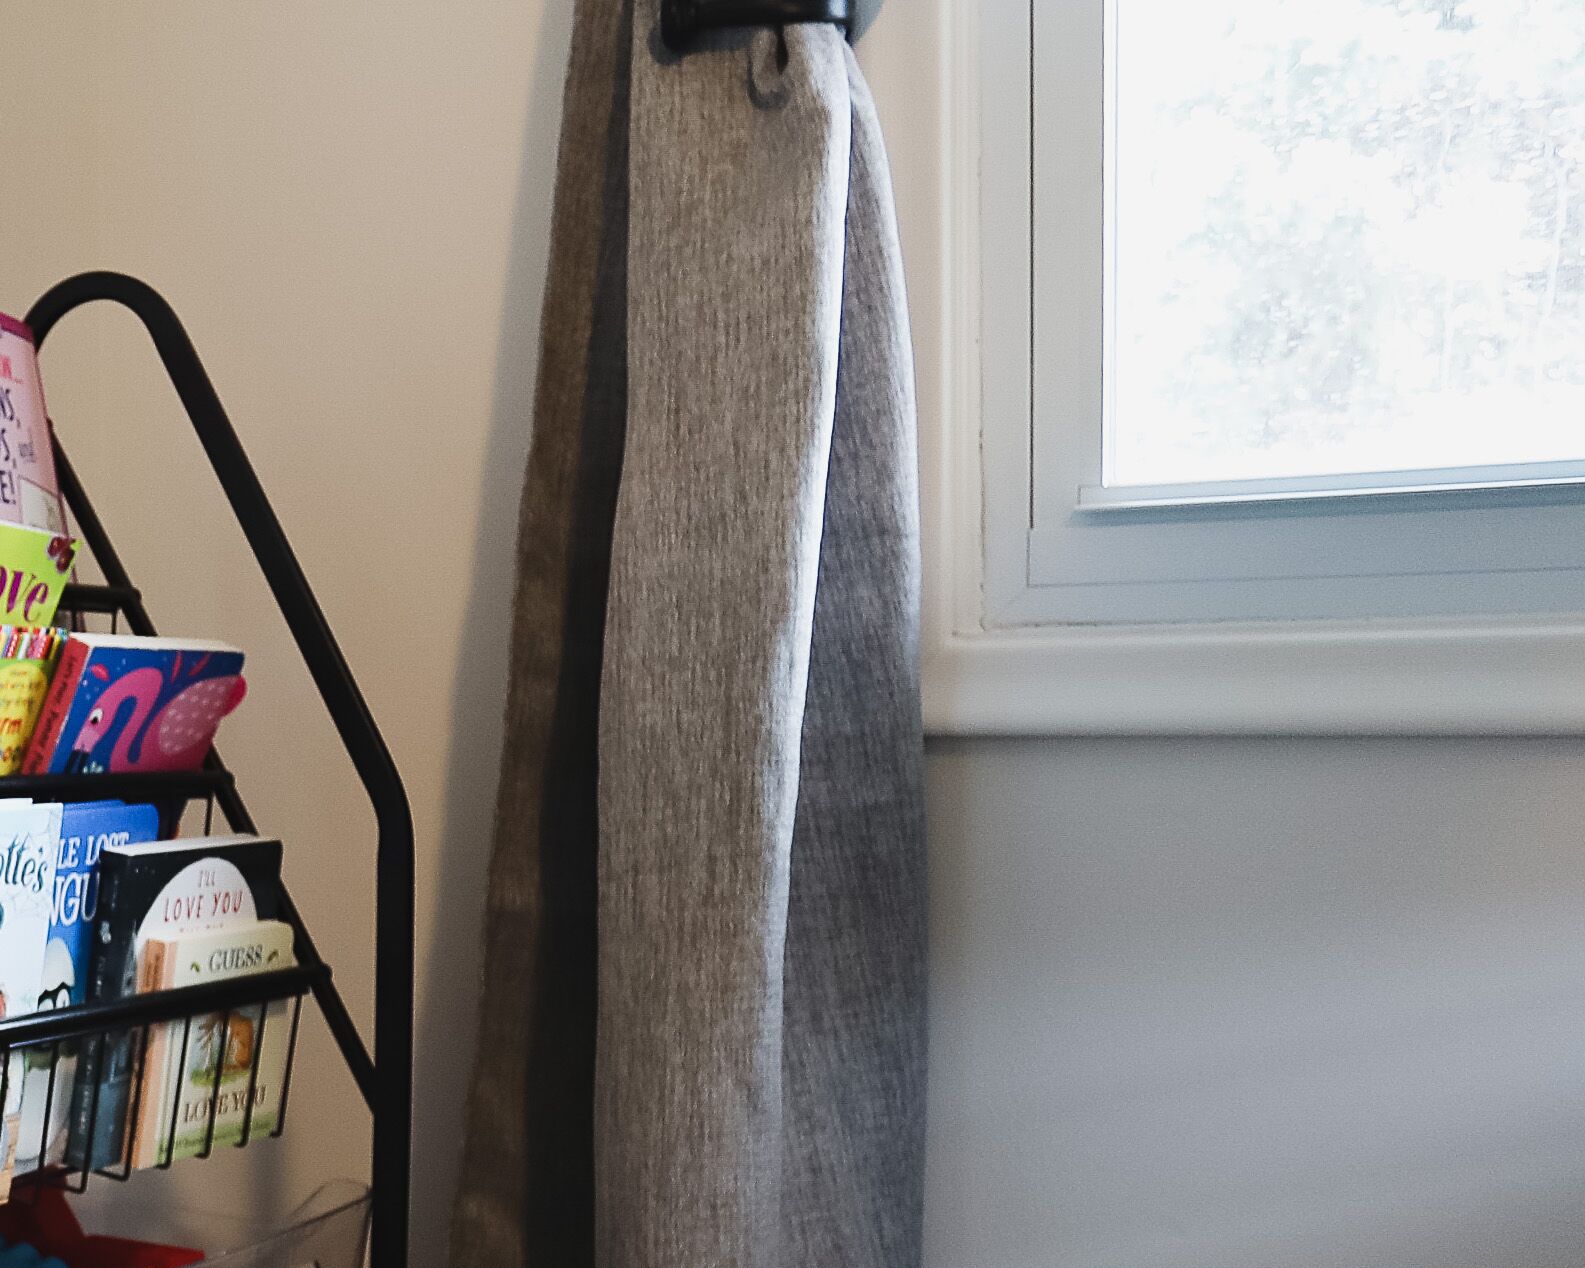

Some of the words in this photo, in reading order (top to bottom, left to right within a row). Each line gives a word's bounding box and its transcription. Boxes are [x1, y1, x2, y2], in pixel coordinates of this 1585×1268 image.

[163, 894, 204, 923] LOVE
[211, 890, 243, 917] YOU
[209, 944, 264, 973] GUESS
[183, 1092, 229, 1124] LOE
